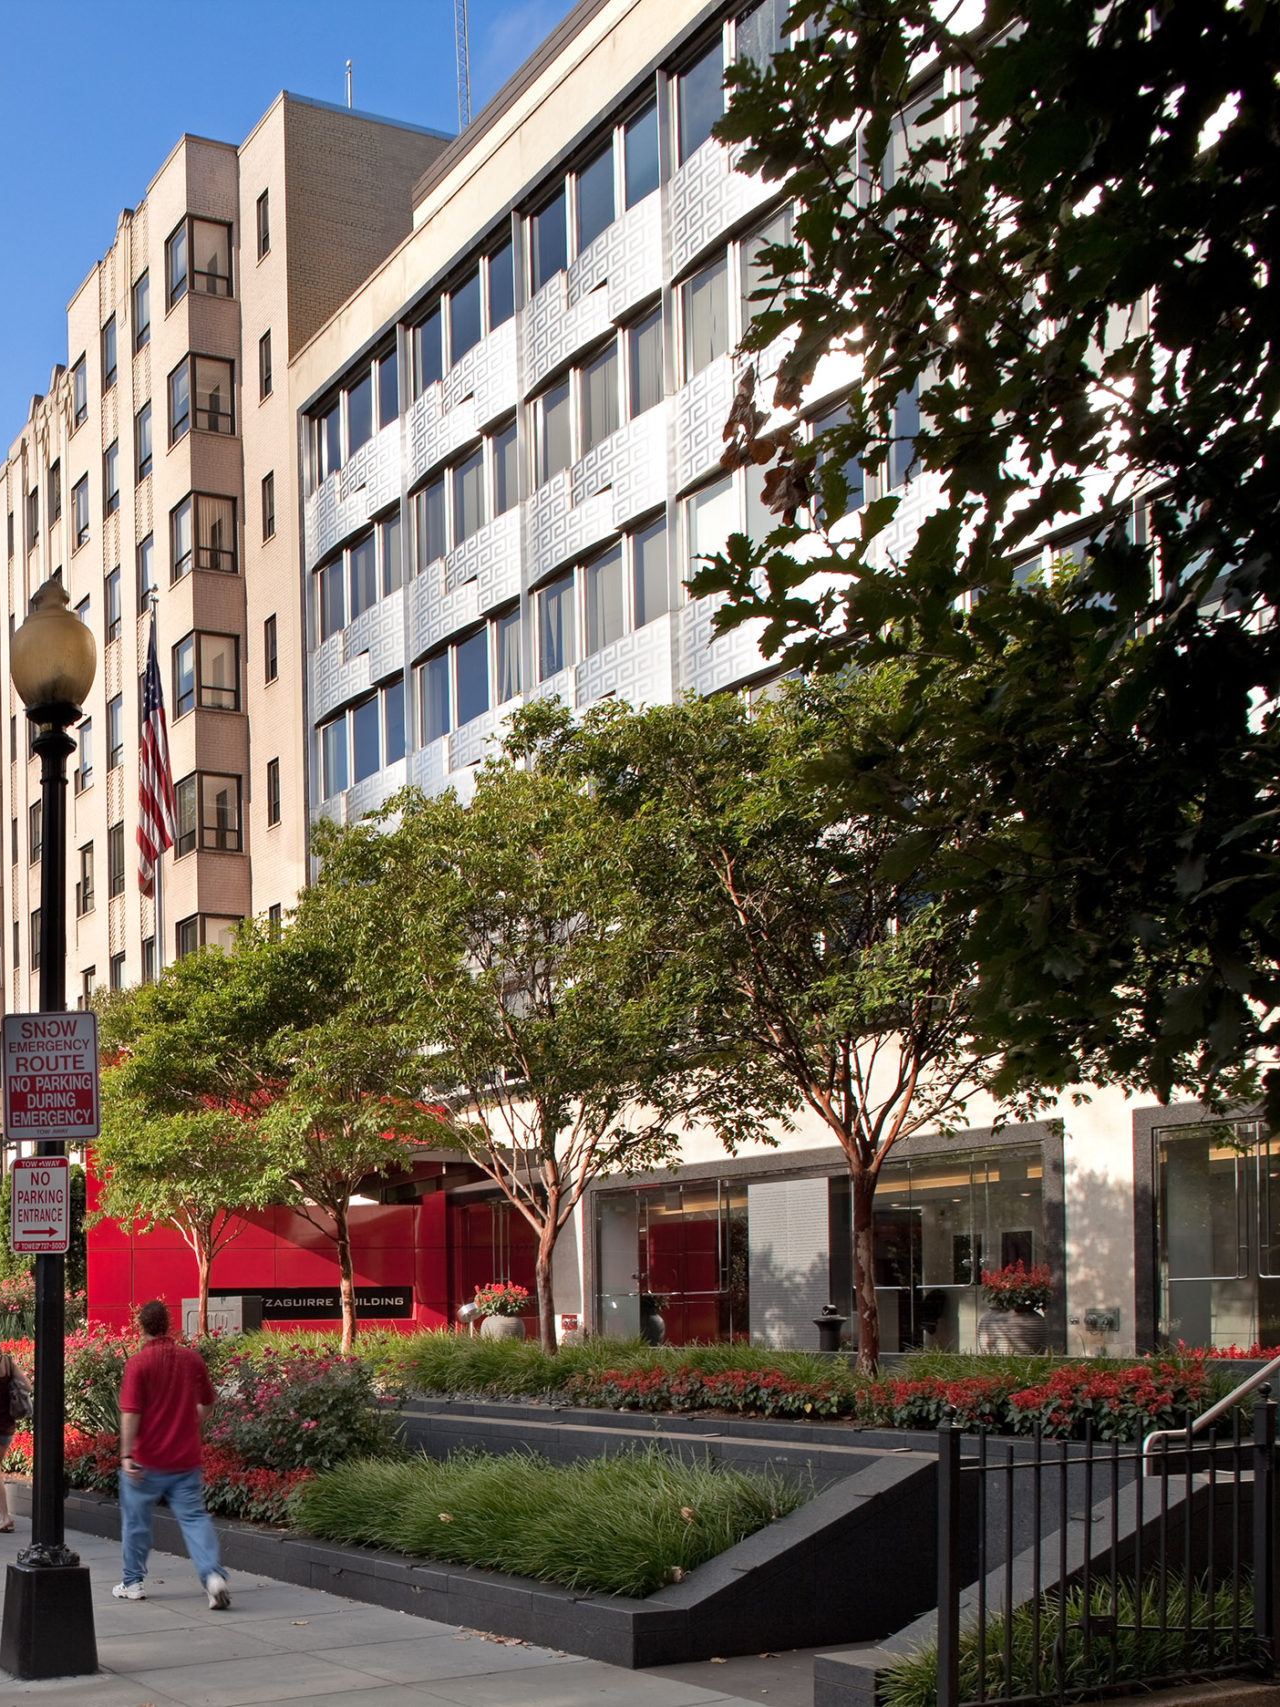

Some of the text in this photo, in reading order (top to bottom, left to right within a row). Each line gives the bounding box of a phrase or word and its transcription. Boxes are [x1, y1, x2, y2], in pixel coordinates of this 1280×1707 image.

[21, 1020, 77, 1039] SNOW
[8, 1038, 90, 1053] EMERGENCY
[16, 1054, 85, 1072] ROUTE
[11, 1074, 92, 1092] NO PARKING
[27, 1091, 76, 1109] DURING
[12, 1108, 91, 1126] EMERGENCY
[21, 1160, 38, 1168] TOW
[30, 1171, 50, 1186] NO
[17, 1189, 64, 1205] PARKING
[17, 1208, 63, 1223] ENTRANCE
